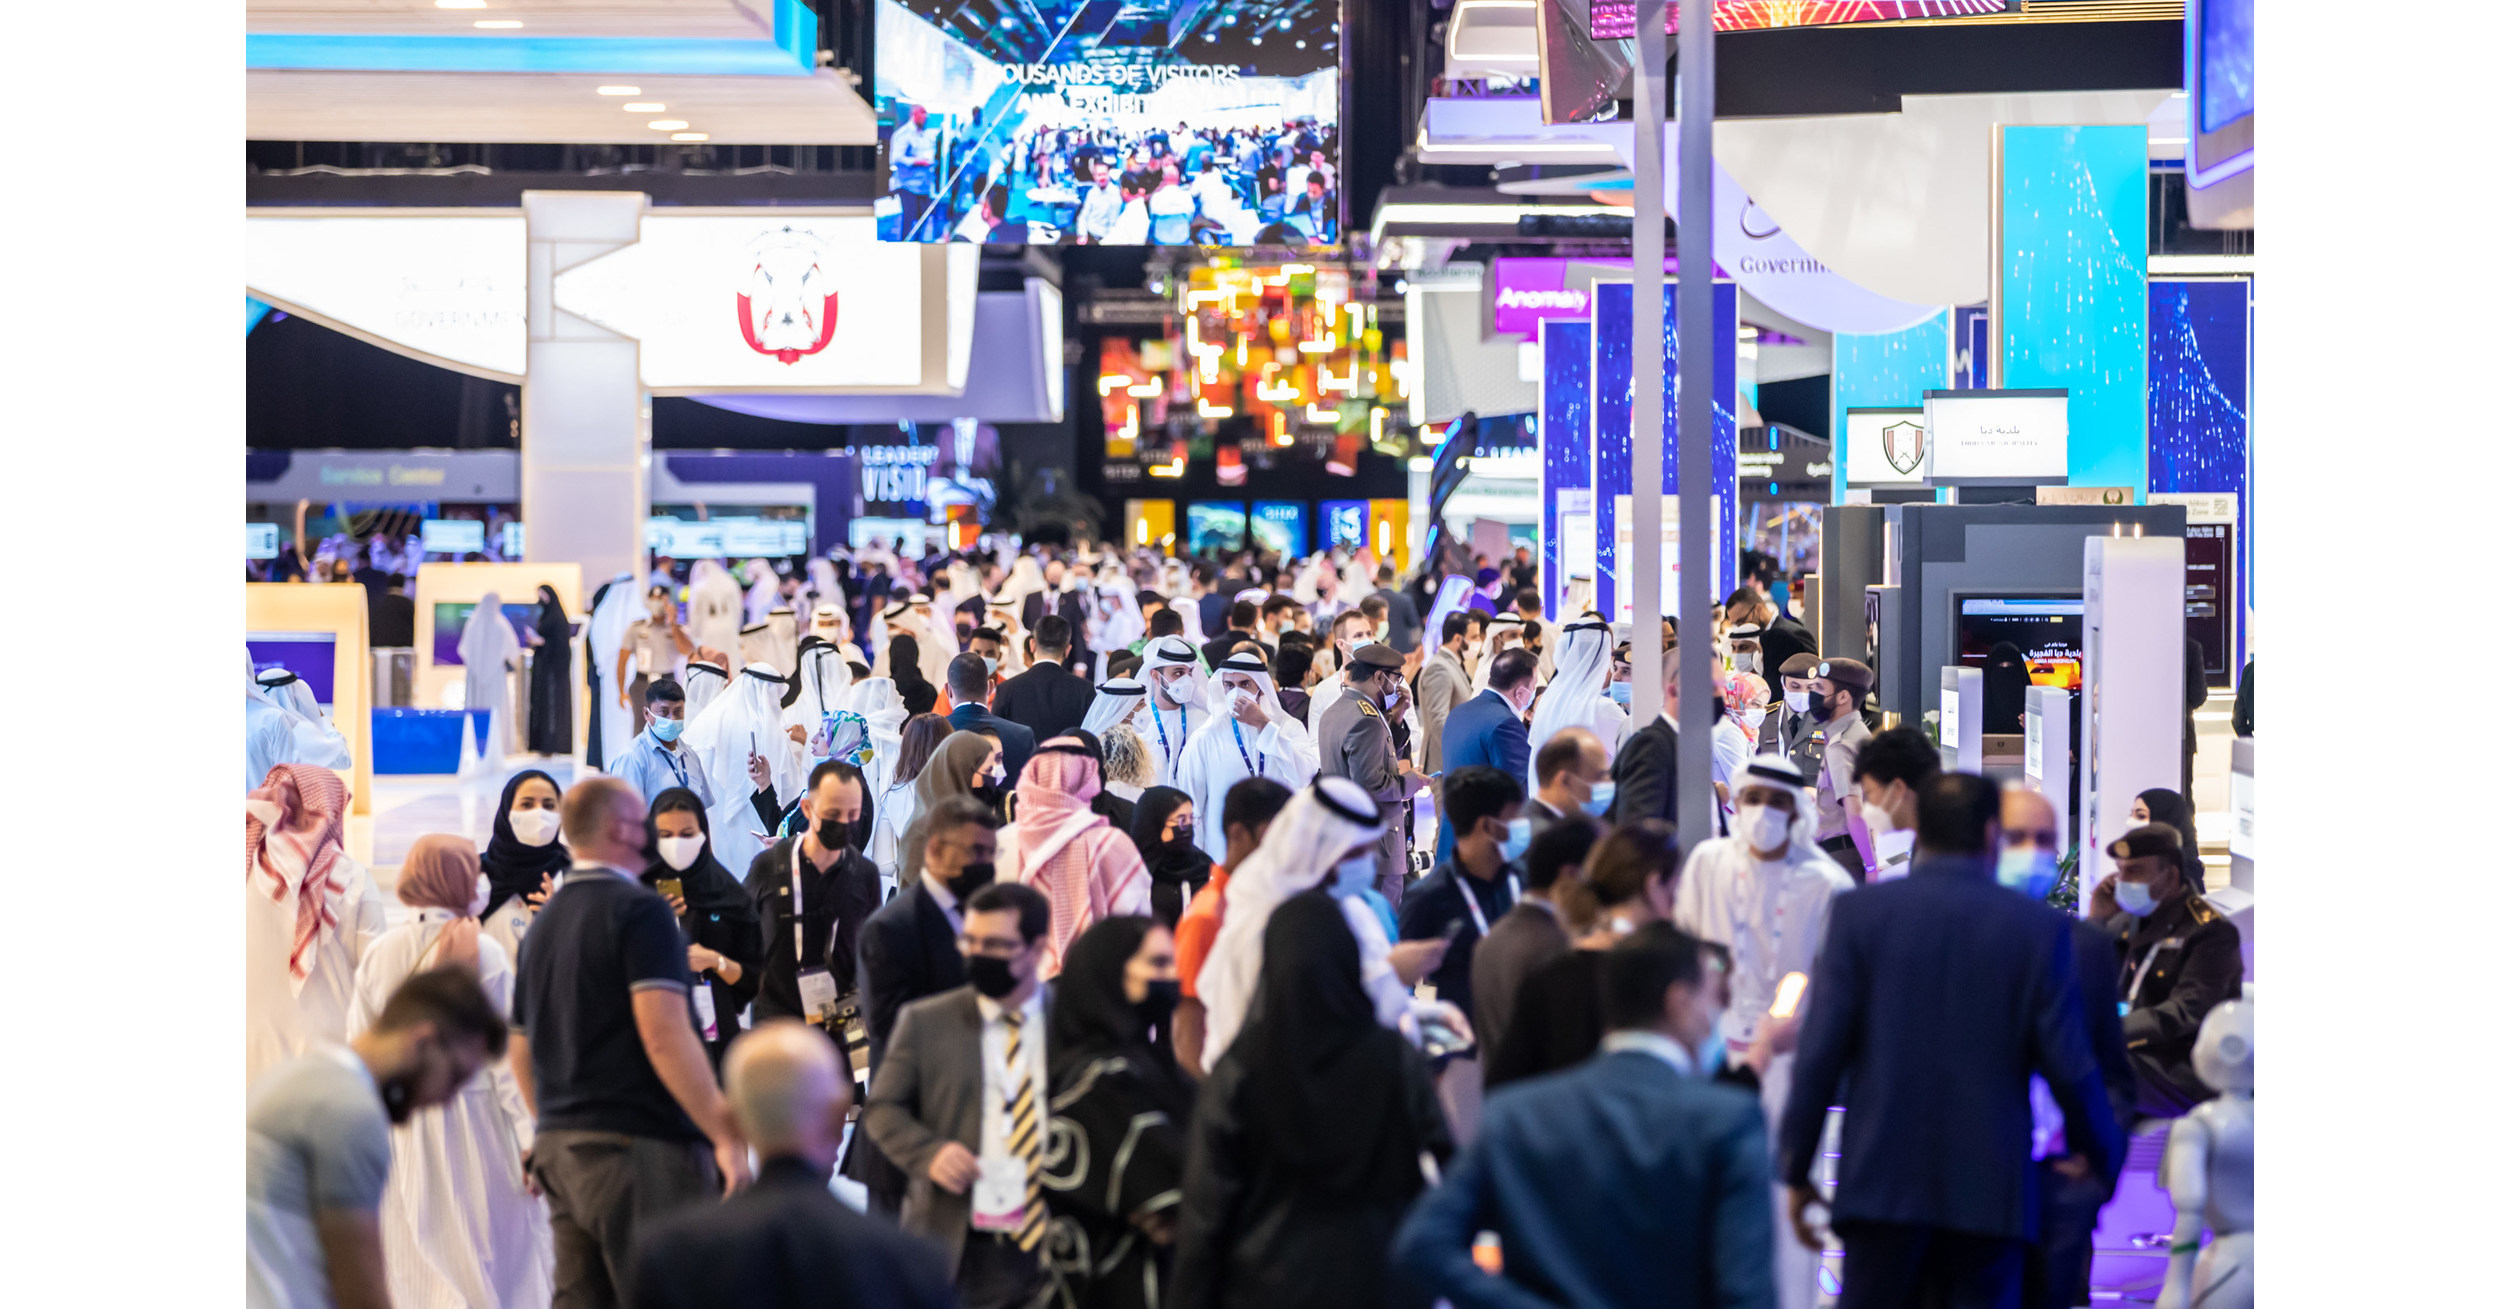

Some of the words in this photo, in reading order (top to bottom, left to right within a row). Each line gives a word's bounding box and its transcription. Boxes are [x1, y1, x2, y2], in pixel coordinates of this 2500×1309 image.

[1000, 64, 1105, 85] OUSANDS
[1110, 65, 1141, 86] OF
[1146, 65, 1241, 86] VISITORS
[1495, 287, 1589, 313] Anomaly
